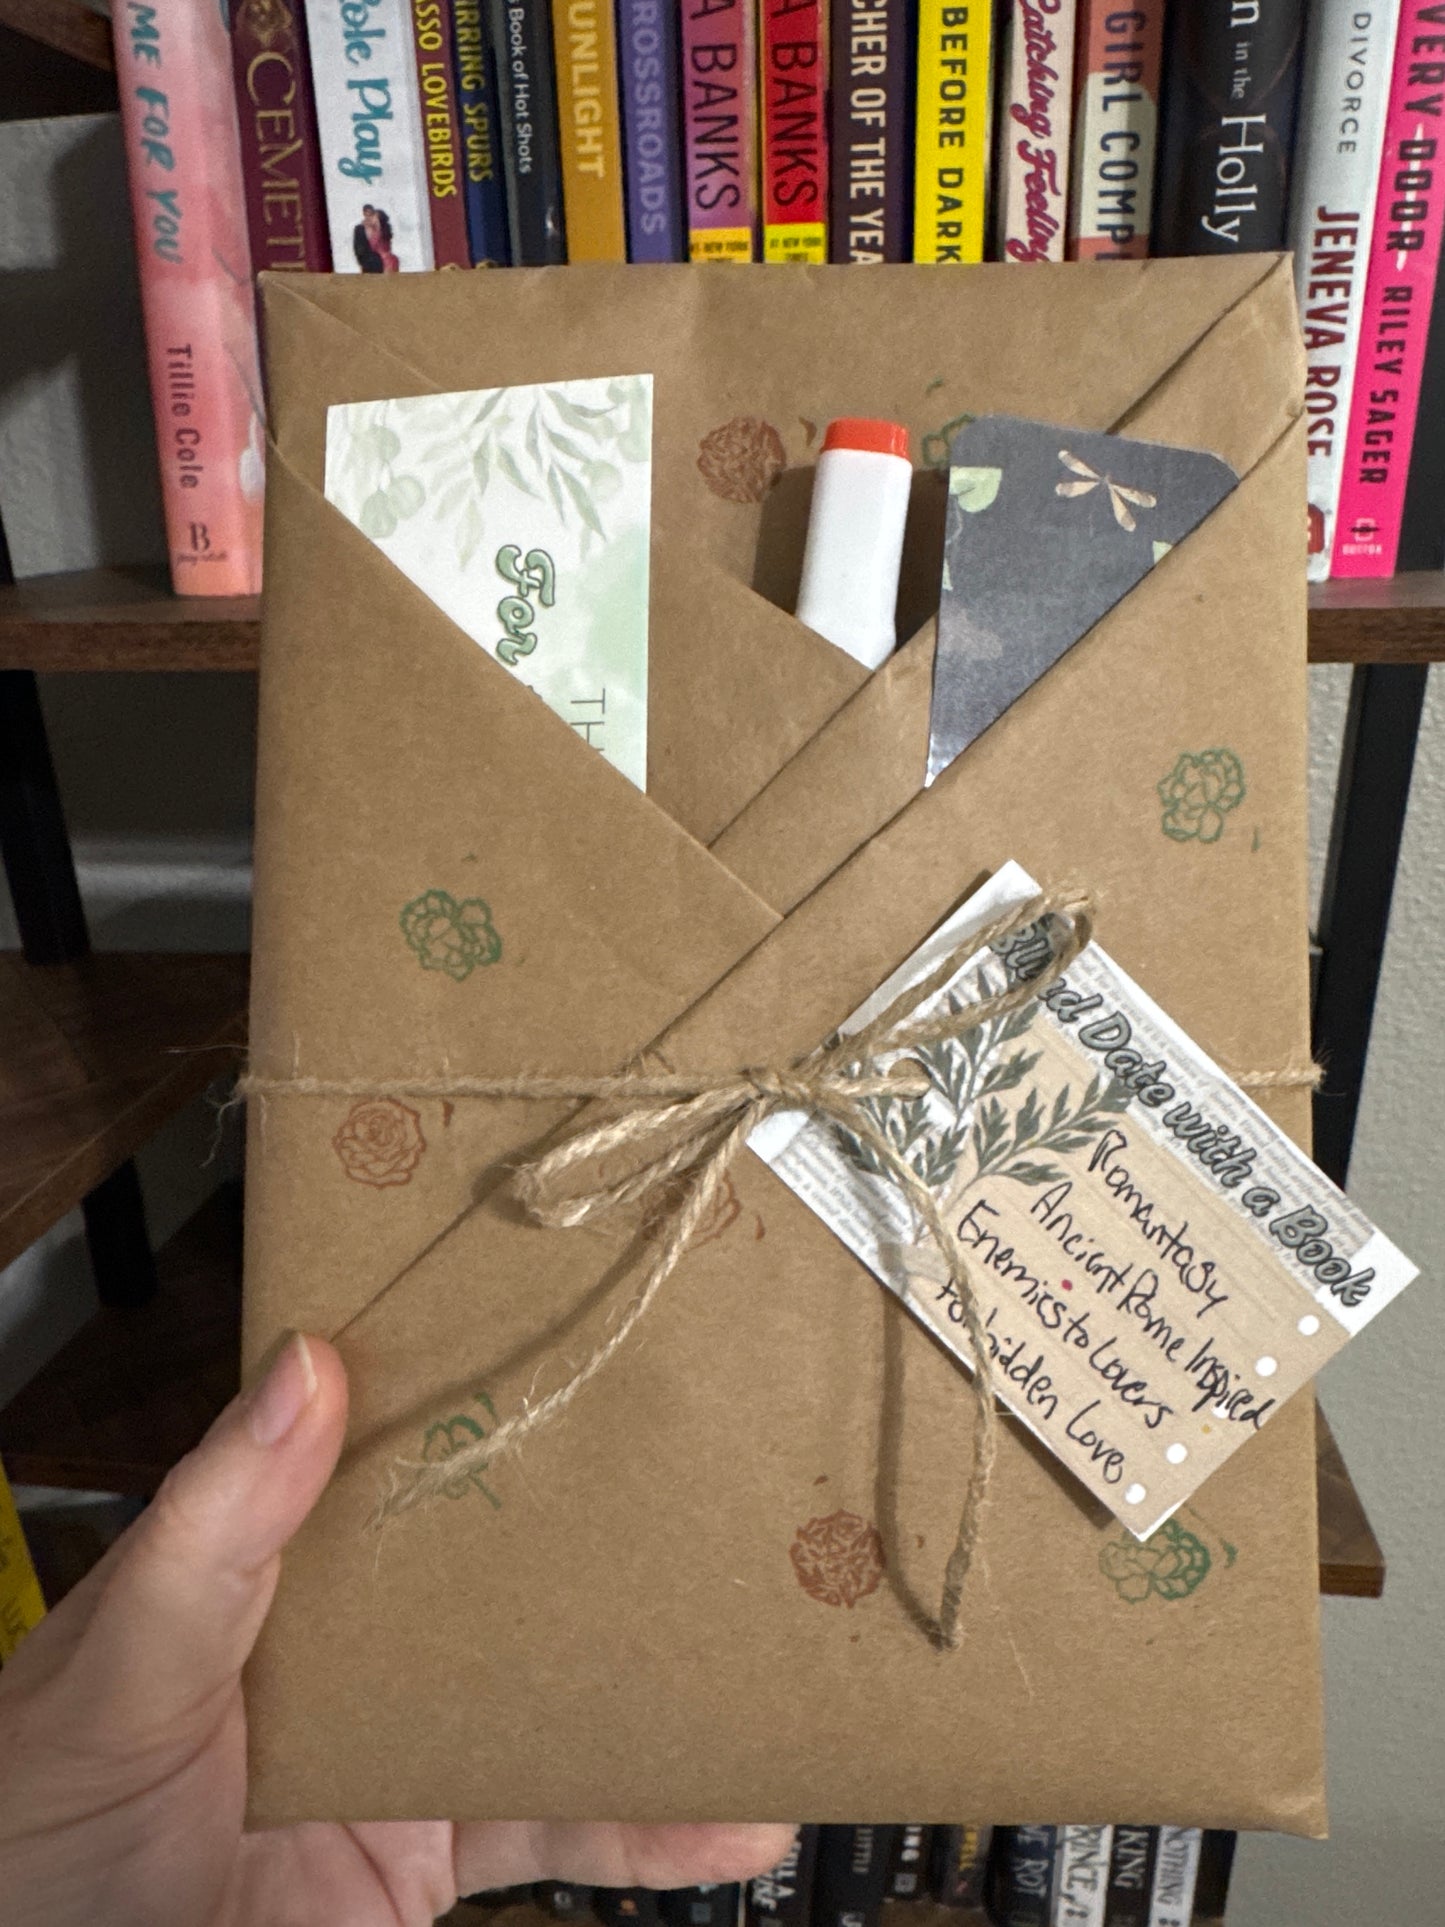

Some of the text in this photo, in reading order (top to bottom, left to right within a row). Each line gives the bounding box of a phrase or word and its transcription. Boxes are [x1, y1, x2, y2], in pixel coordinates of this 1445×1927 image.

[128, 3, 184, 264] ME FOR YOU
[337, 0, 393, 184] ole Play
[416, 0, 457, 198] SSO LOVEBIRDS
[508, 7, 533, 174] Book of Hot Shots
[568, 4, 605, 179] UNLIGHT
[632, 3, 667, 236] ROSSROADS
[691, 44, 740, 210] BANKS
[771, 41, 819, 207] BANKS
[850, 88, 887, 128] OF
[936, 7, 968, 263] BEFORE DARK
[1095, 10, 1146, 260] GIRL COMP
[1232, 67, 1251, 98] the
[1235, 41, 1252, 61] in
[1338, 12, 1371, 154] DIVORCE
[247, 51, 306, 271] CEMET
[463, 103, 493, 182] SPURS
[850, 137, 887, 200] THE
[1202, 114, 1267, 243] Holly
[1305, 205, 1360, 457] JENEVA ROSE
[1359, 3, 1445, 484] VERY DOOR RILEY SAGER
[167, 344, 203, 489] Tillie Cole
[496, 544, 555, 665] For
[1078, 1010, 1176, 1107] Date
[1163, 1102, 1257, 1188] with
[1242, 1186, 1281, 1217] a
[1269, 1204, 1376, 1308] Book
[1087, 1129, 1228, 1318] Romantasy
[1031, 1181, 1133, 1293] Ancient
[1116, 1268, 1186, 1362] Rome
[935, 1279, 1125, 1484] Fobidden Love
[1063, 1312, 1091, 1349] to
[1088, 1336, 1174, 1429] Lovers
